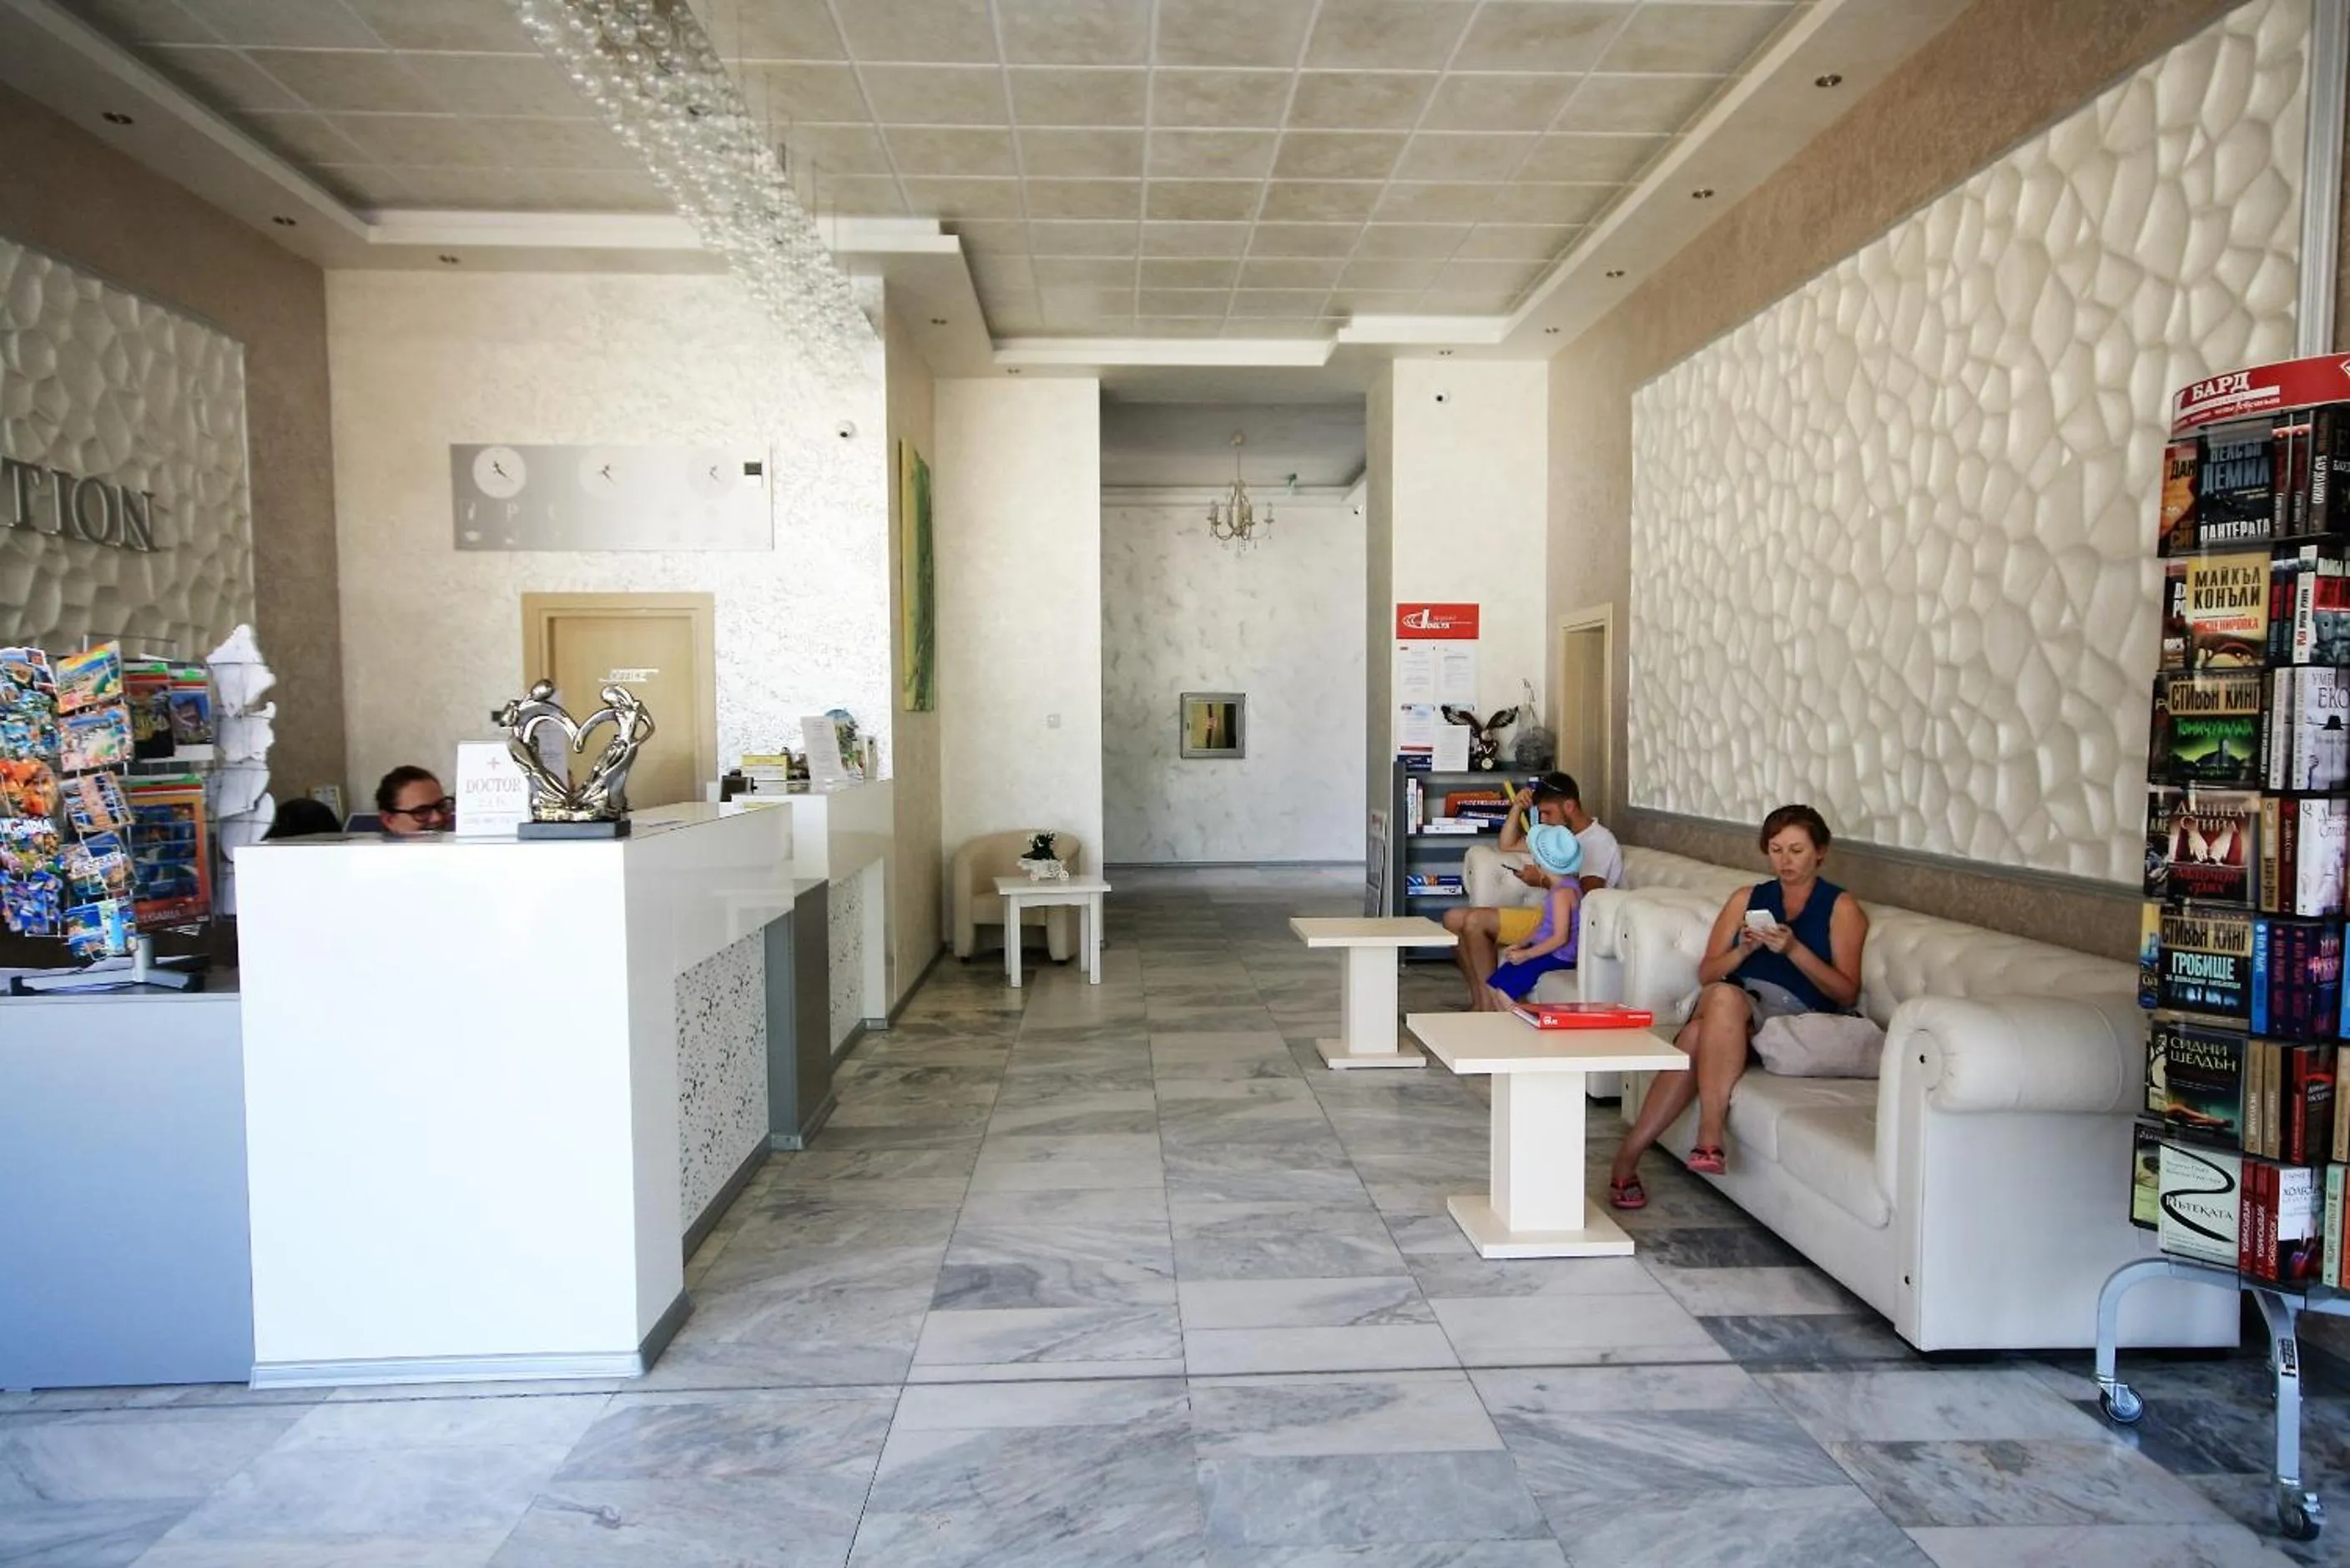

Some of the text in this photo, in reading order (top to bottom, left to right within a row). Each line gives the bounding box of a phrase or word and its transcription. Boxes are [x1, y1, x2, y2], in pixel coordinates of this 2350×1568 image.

[2192, 371, 2251, 401] БАРД
[2201, 457, 2269, 496] ДЕМИЛ
[2200, 518, 2270, 541] ПАНТЕРАТА
[2195, 566, 2261, 587] МАЙКЪЛ
[2194, 586, 2261, 609] КОНЪЛИ
[2171, 682, 2259, 711] СТИВЪН КИНГ
[465, 777, 522, 794] DOCTOR
[2162, 918, 2207, 948] СТИВЪН
[2213, 922, 2248, 951] КИНГ
[2172, 951, 2235, 981] ГРОБИЩЕ
[2171, 1036, 2227, 1056] СИДНИ
[2171, 1050, 2236, 1071] ШЕЛДЪН
